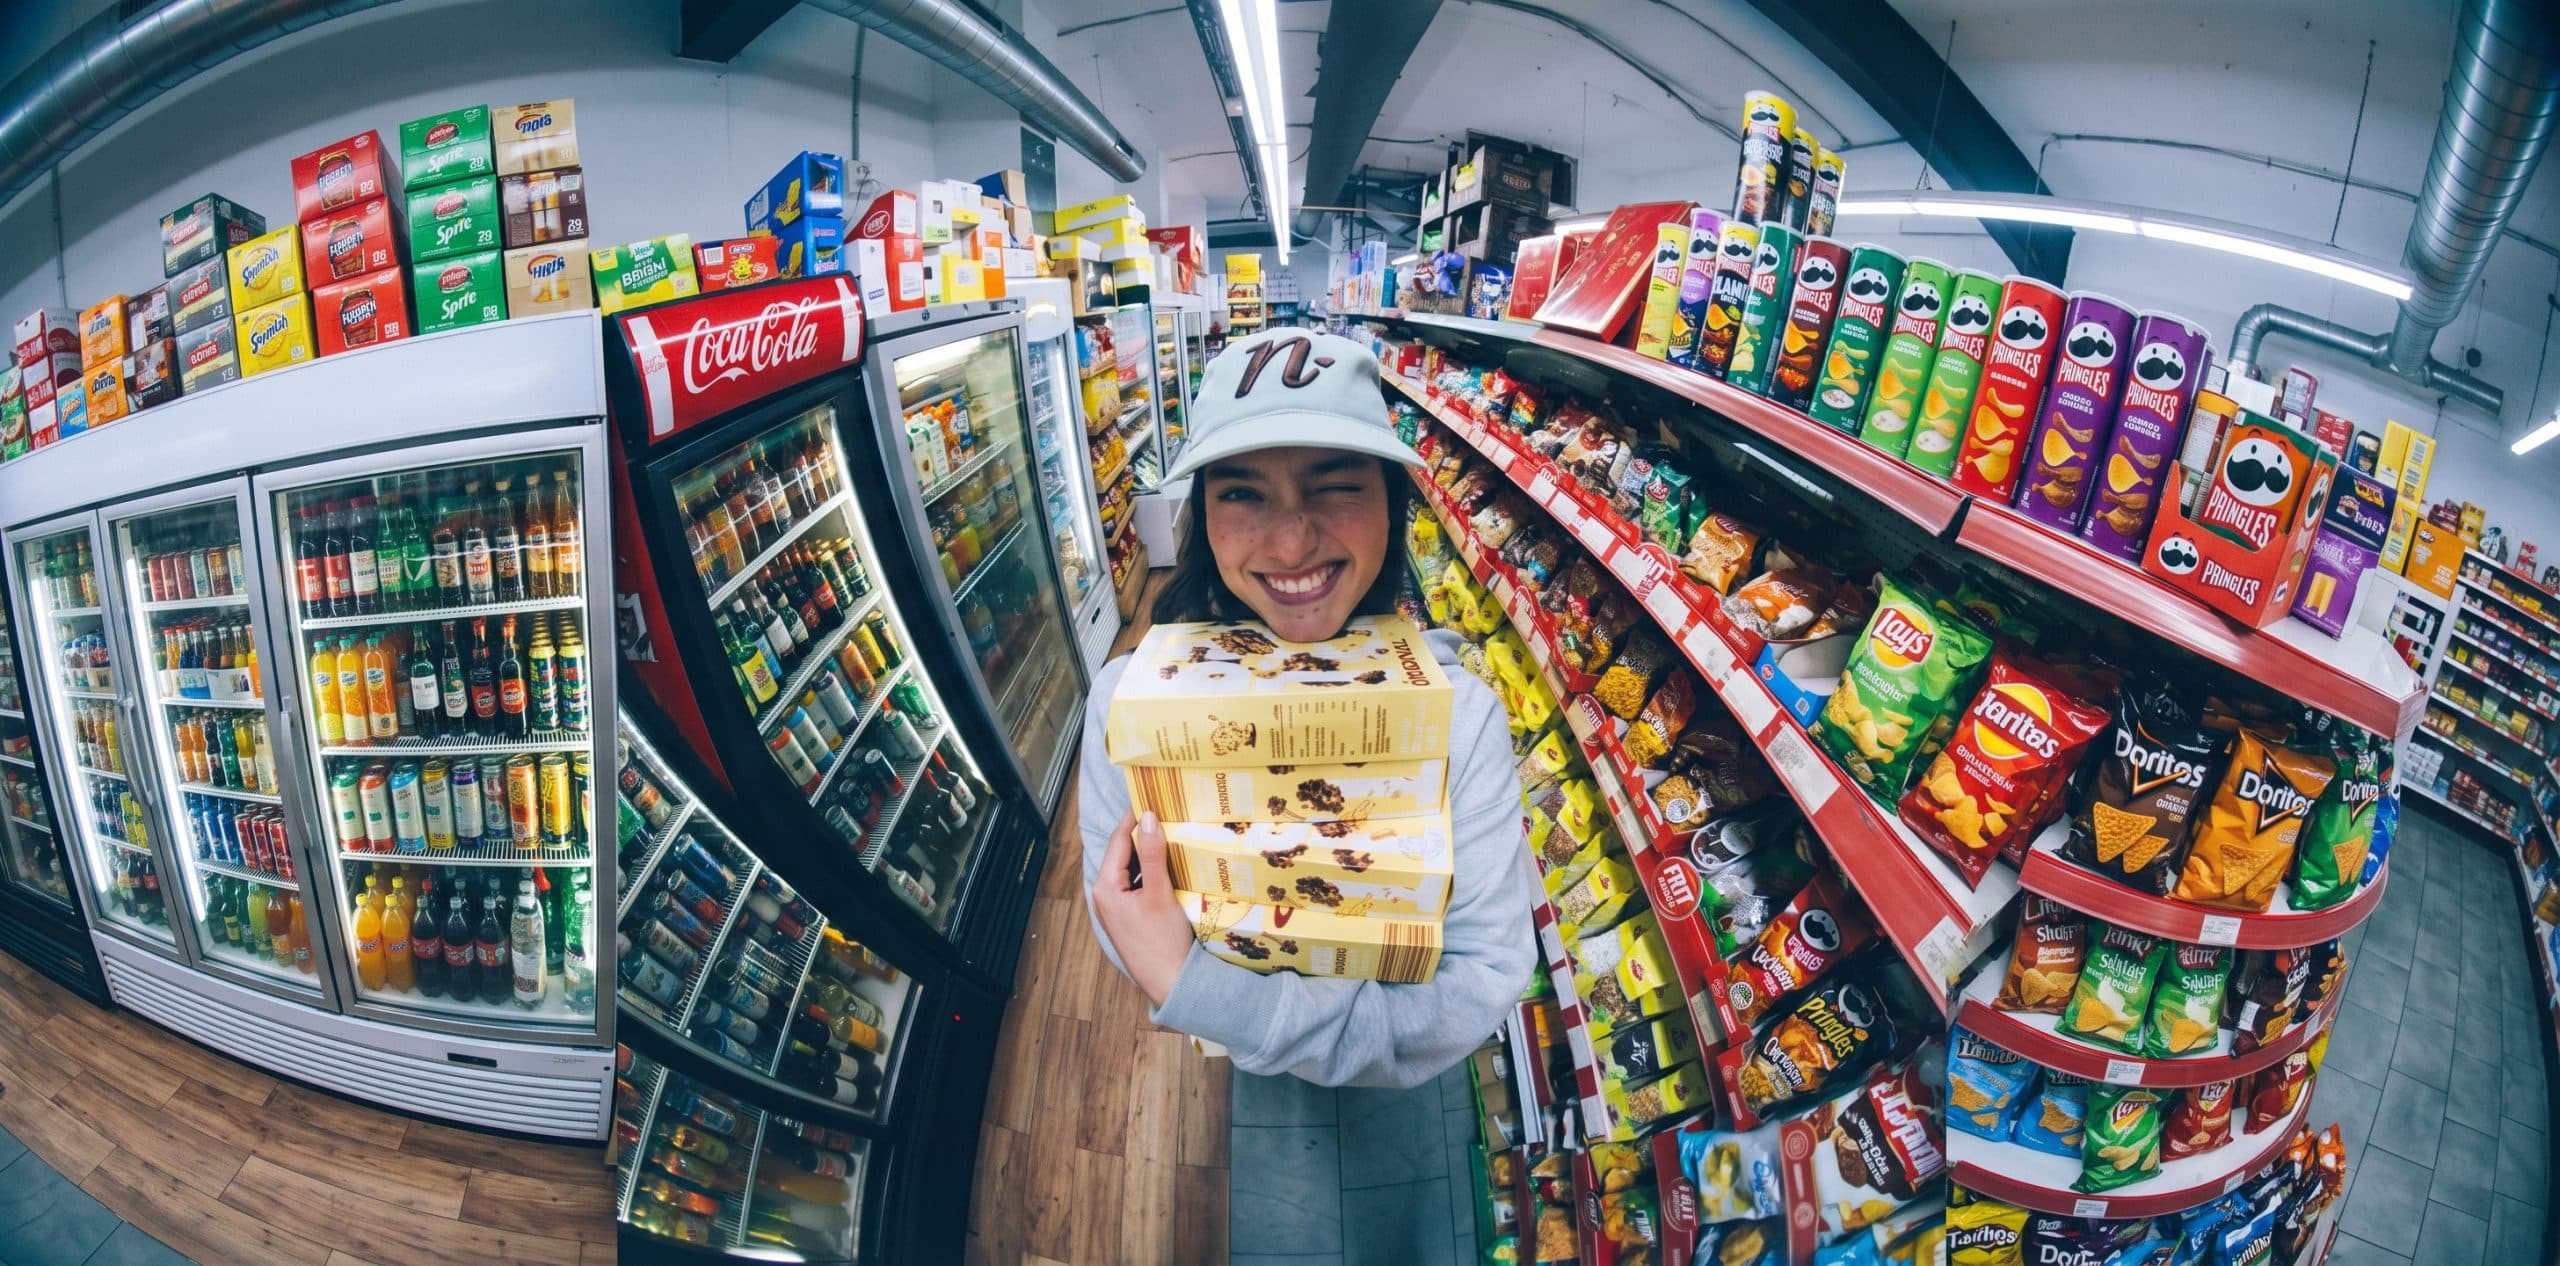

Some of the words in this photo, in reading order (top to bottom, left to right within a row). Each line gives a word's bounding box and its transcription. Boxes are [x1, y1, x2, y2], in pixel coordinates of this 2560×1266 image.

[683, 296, 820, 394] Coca-Cola
[1992, 340, 2042, 379] PRINGLES
[2057, 357, 2110, 398] PRINGLES
[2124, 380, 2178, 422] PRINGLES
[2203, 488, 2277, 549] PRINGLES
[2201, 558, 2261, 606] PRINGLES
[2114, 727, 2207, 789] Doritos
[1663, 863, 1695, 905] FRIT
[1797, 996, 1854, 1058] Pringles
